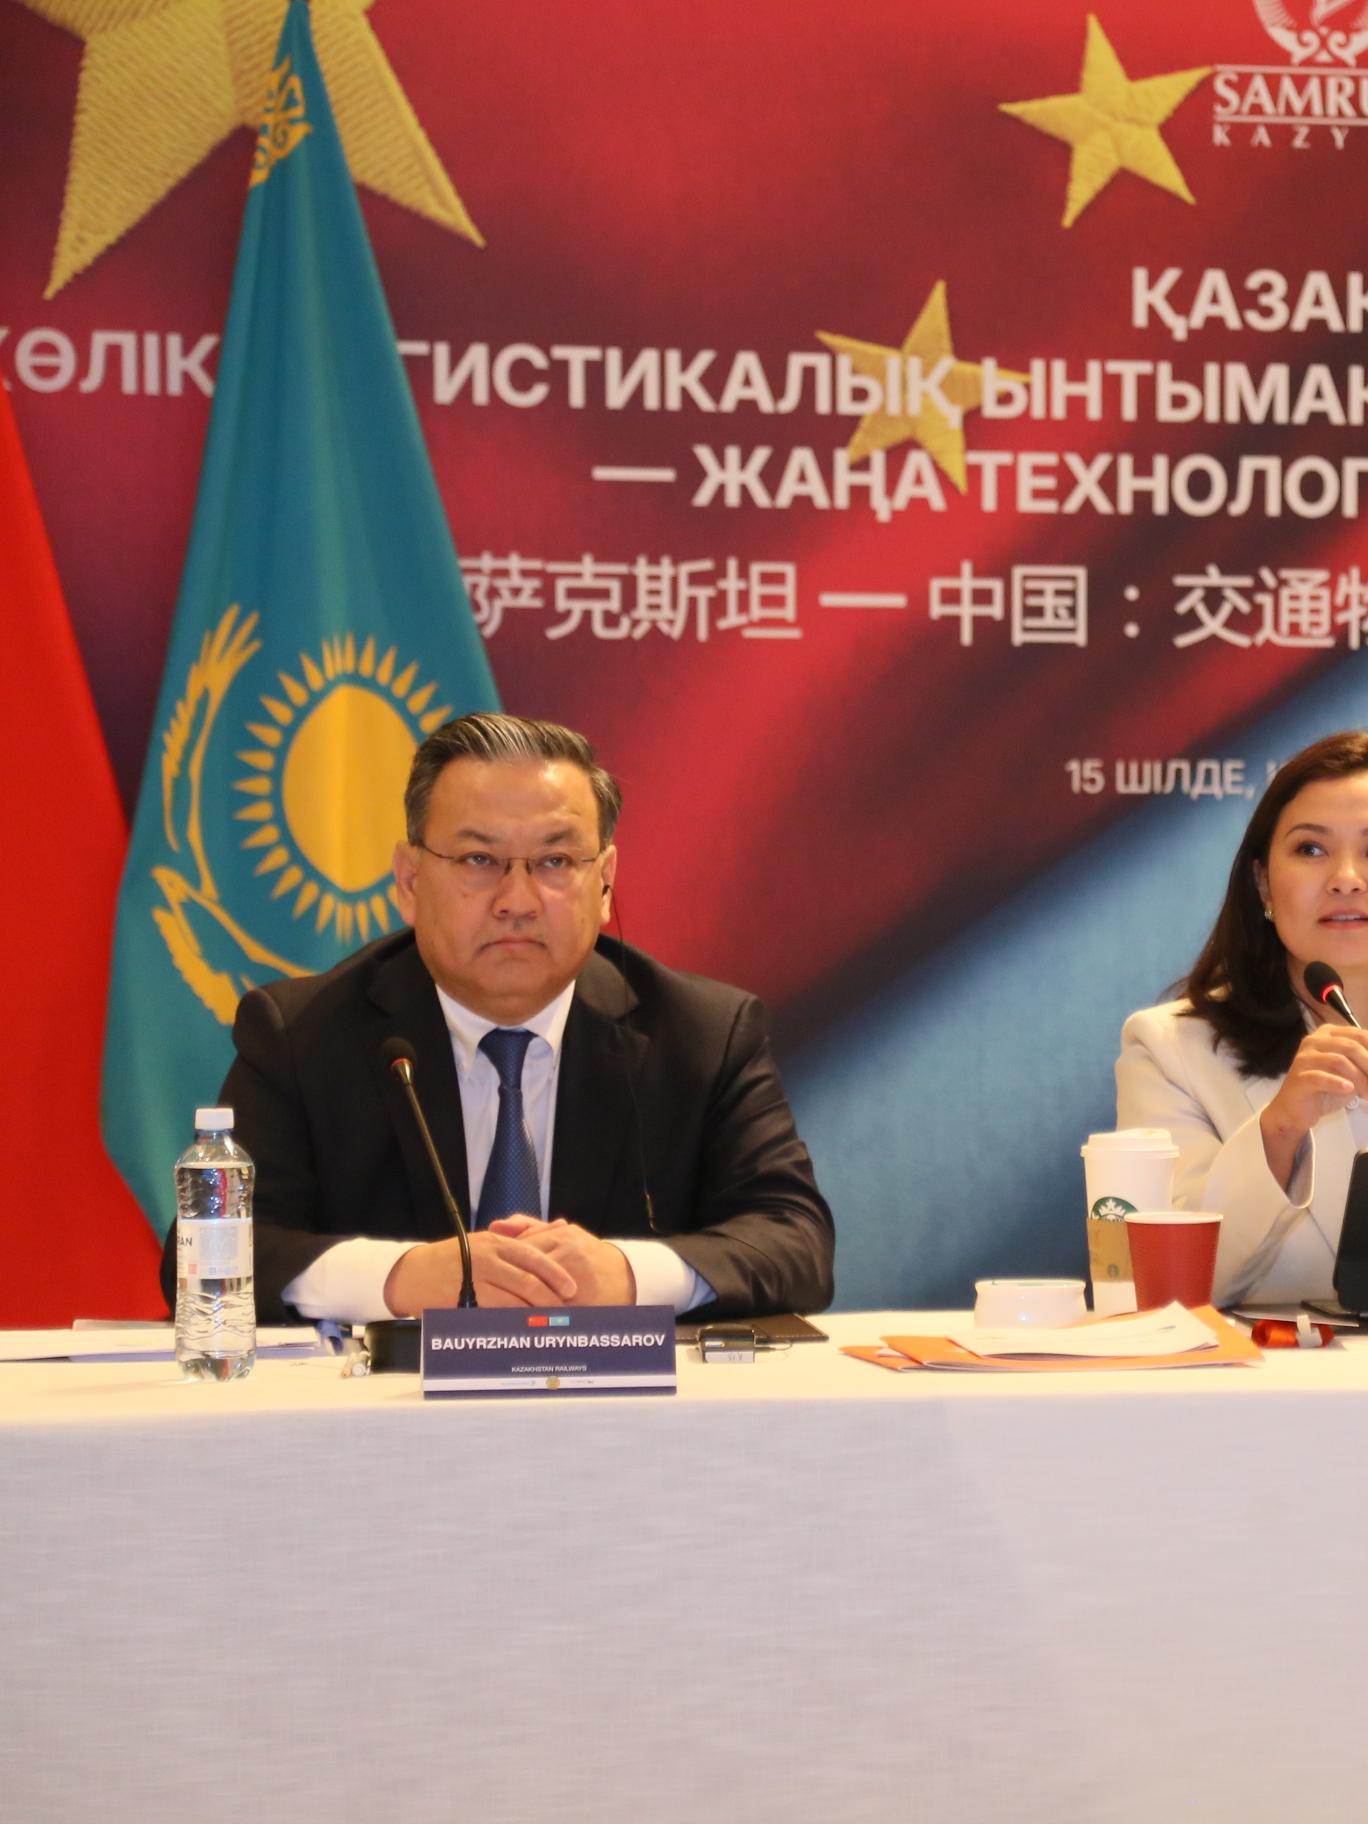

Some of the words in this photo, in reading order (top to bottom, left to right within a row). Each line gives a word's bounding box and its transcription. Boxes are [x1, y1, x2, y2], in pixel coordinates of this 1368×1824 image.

[691, 445, 946, 522] ЖАҢА
[1065, 758, 1106, 795] 15
[1114, 758, 1255, 800] ШІЛДЕ,
[431, 1336, 530, 1350] BAUYRZHAN
[533, 1334, 666, 1349] URYNBASSAROV
